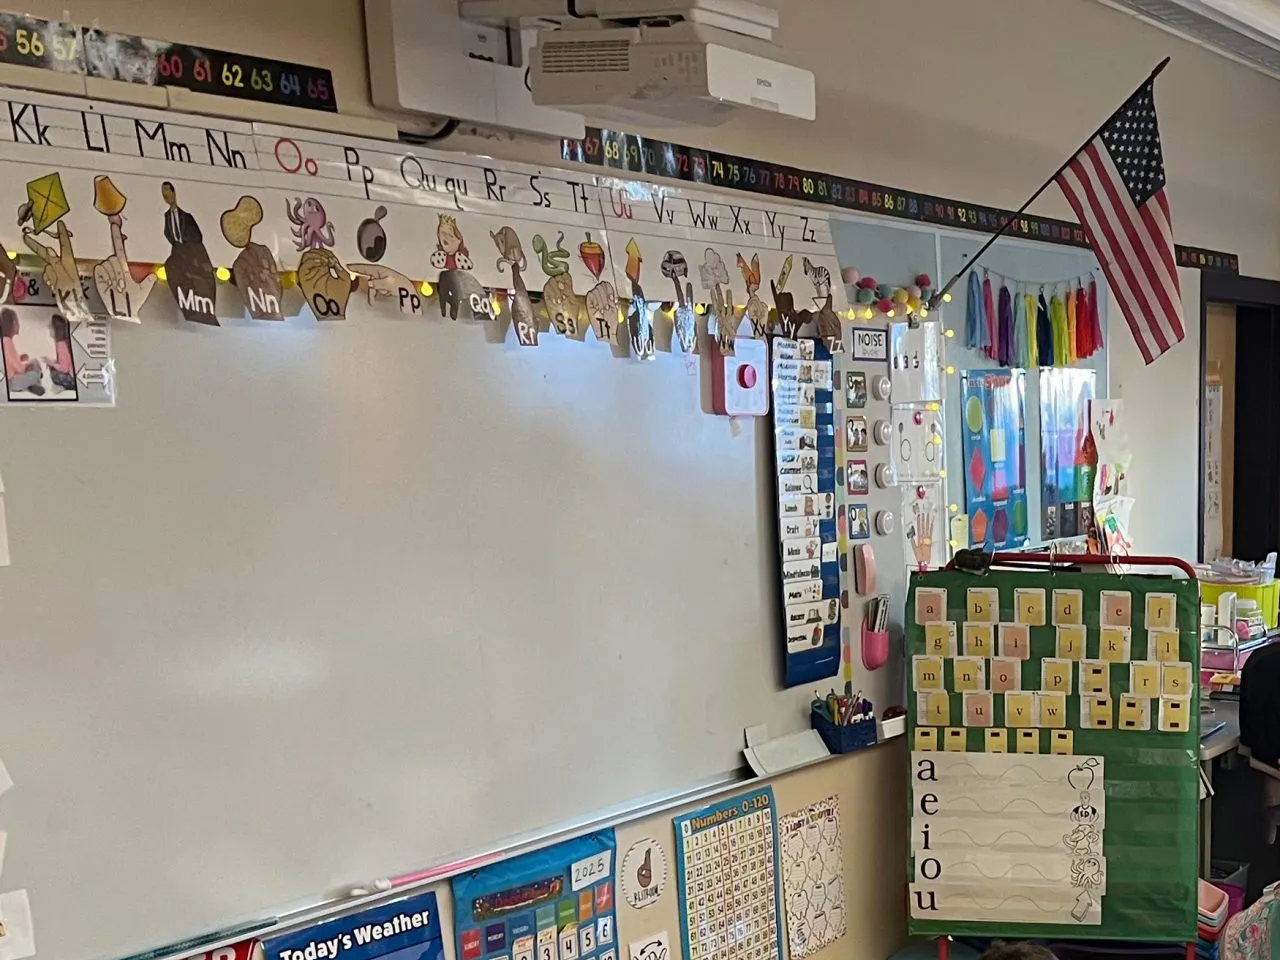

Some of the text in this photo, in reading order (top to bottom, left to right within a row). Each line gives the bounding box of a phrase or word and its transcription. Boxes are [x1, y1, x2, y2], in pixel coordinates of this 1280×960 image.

[16, 29, 77, 60] 56 57
[158, 54, 329, 100] 60 61 62 63 64 65
[8, 100, 53, 146] Kk
[81, 111, 110, 153] Ll
[134, 119, 192, 163] Mm
[205, 129, 247, 169] Nn
[275, 138, 318, 176] Oo
[344, 147, 374, 200] Pp
[399, 154, 437, 193] Qu
[483, 168, 507, 201] Rr
[530, 175, 552, 208] Ss
[566, 181, 589, 214] Tt
[650, 193, 675, 225] Vv
[687, 199, 719, 230] Ww
[730, 205, 751, 236] Xx
[765, 211, 785, 250] Yy
[800, 216, 816, 243] Zz
[585, 138, 599, 154] 67
[605, 141, 619, 159] 68
[624, 145, 637, 161] 69
[677, 154, 689, 172] 72
[711, 160, 724, 178] 74
[728, 164, 740, 181] 75
[743, 166, 756, 184] 76
[774, 172, 785, 188] 78
[788, 175, 799, 191] 79
[802, 177, 814, 195] 80
[818, 180, 827, 197] 81
[884, 194, 894, 209] 86
[957, 207, 967, 223] 92
[968, 210, 977, 224] 93
[177, 286, 214, 315] Mm
[247, 287, 279, 313] Nn
[313, 293, 340, 316] Oo
[399, 287, 421, 312] Pp
[518, 321, 534, 344] Rr
[555, 312, 576, 334] Ss
[596, 317, 610, 339] Tt
[752, 318, 766, 337] Xx
[782, 313, 796, 340] Yy
[827, 337, 842, 354] Zz
[858, 333, 882, 347] NOISE
[926, 605, 934, 613] a
[974, 603, 982, 614] b
[1027, 605, 1034, 614] c
[1063, 604, 1071, 615] d
[1115, 607, 1122, 616] e
[934, 637, 942, 649] g
[975, 636, 983, 647] h
[1067, 640, 1073, 652] j
[1108, 640, 1116, 651] k
[923, 672, 1179, 687] m n o p r s
[975, 707, 983, 715] u
[1048, 708, 1058, 716] w
[916, 758, 938, 781] a
[691, 794, 769, 830] Numbers 0-120
[920, 793, 938, 815] e
[921, 823, 930, 849] i
[575, 858, 604, 883] 2025
[920, 857, 941, 879] o
[914, 888, 938, 911] u
[353, 910, 430, 946] Weather
[565, 939, 572, 954] 4
[585, 932, 591, 947] 5
[602, 923, 608, 938] 6
